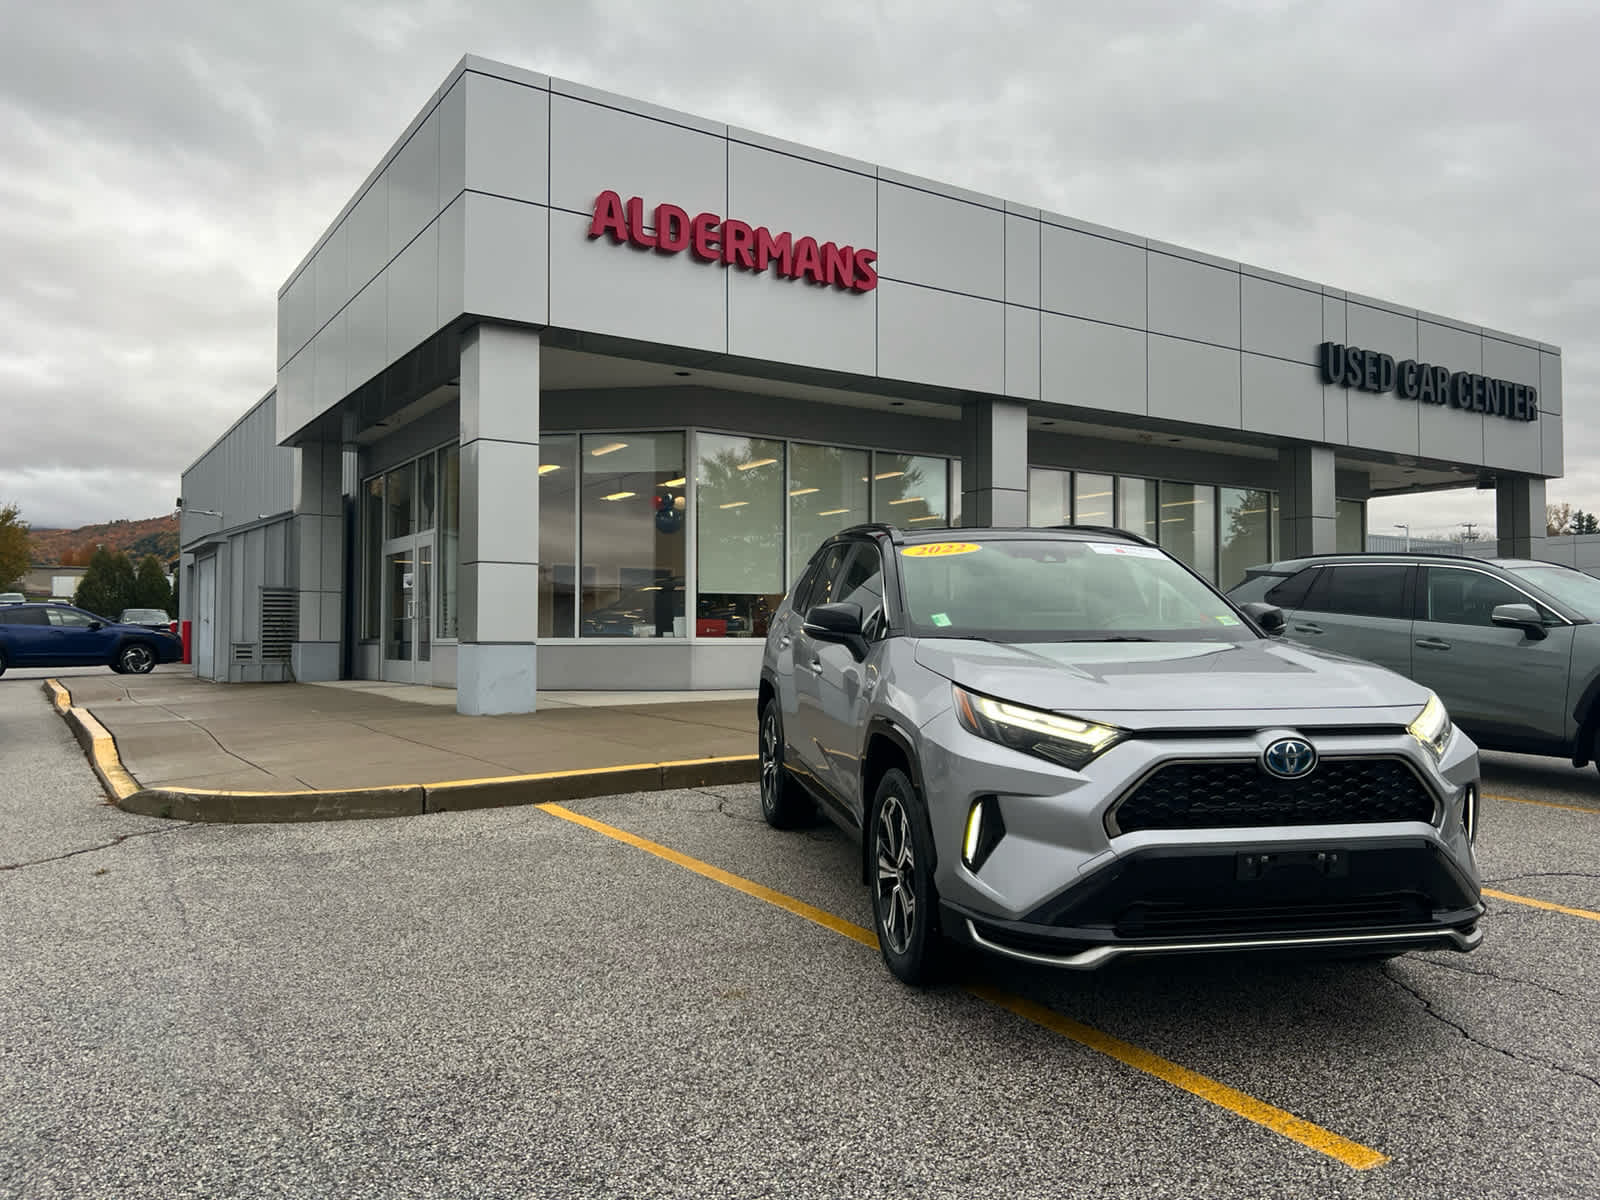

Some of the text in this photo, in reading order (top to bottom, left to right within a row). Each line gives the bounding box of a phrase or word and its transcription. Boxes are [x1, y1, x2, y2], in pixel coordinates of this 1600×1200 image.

[588, 190, 878, 292] ALDERMANS
[1321, 342, 1538, 422] USED CAR CENTER
[917, 543, 966, 556] 2022
